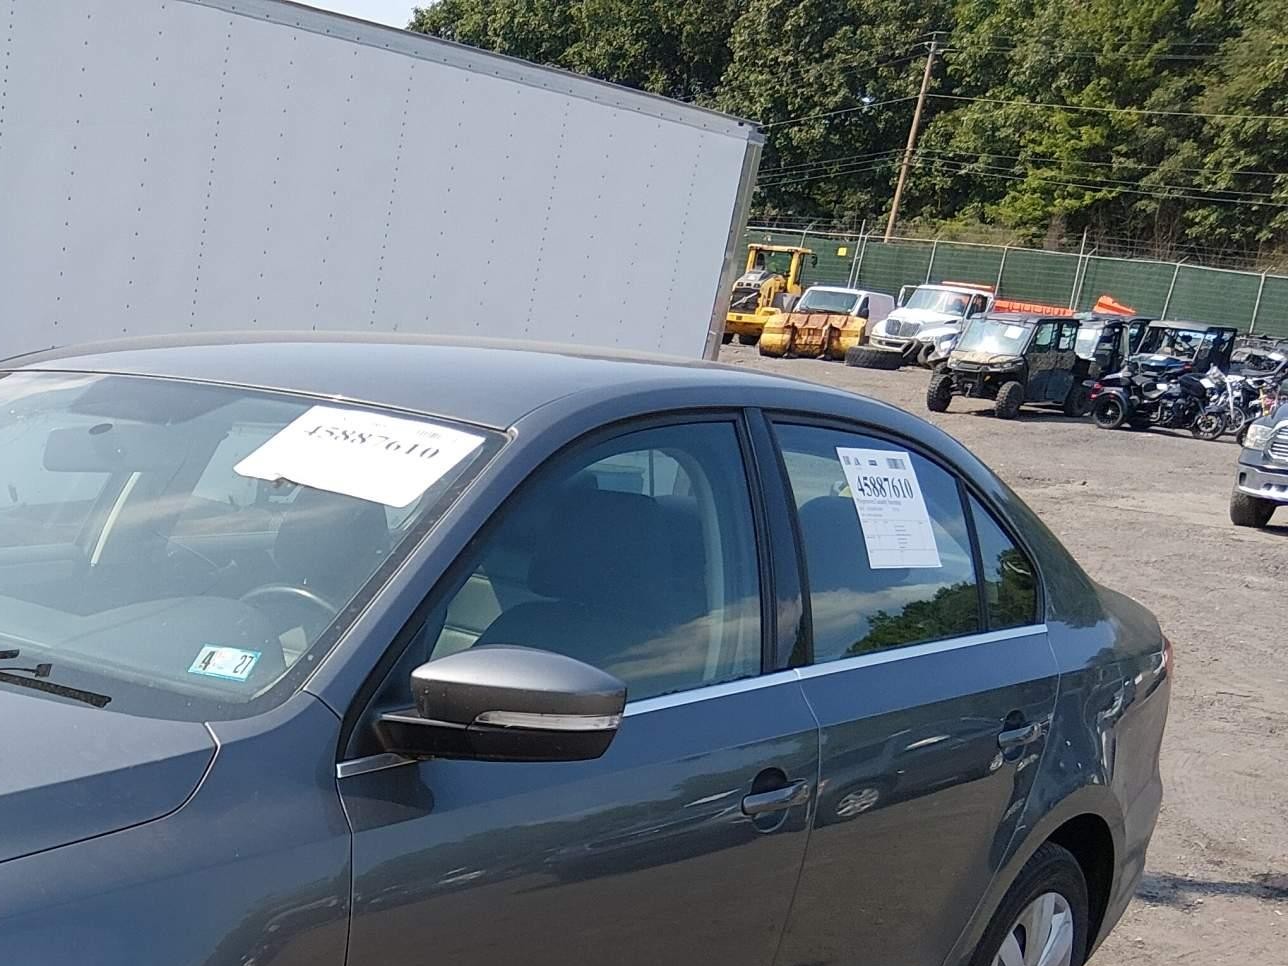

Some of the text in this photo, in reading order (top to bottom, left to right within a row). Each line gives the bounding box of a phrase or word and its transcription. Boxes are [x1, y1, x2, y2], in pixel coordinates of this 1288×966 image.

[304, 425, 440, 459] 45887610
[856, 474, 914, 499] 45887610
[199, 650, 216, 671] 4
[232, 654, 254, 675] 27
